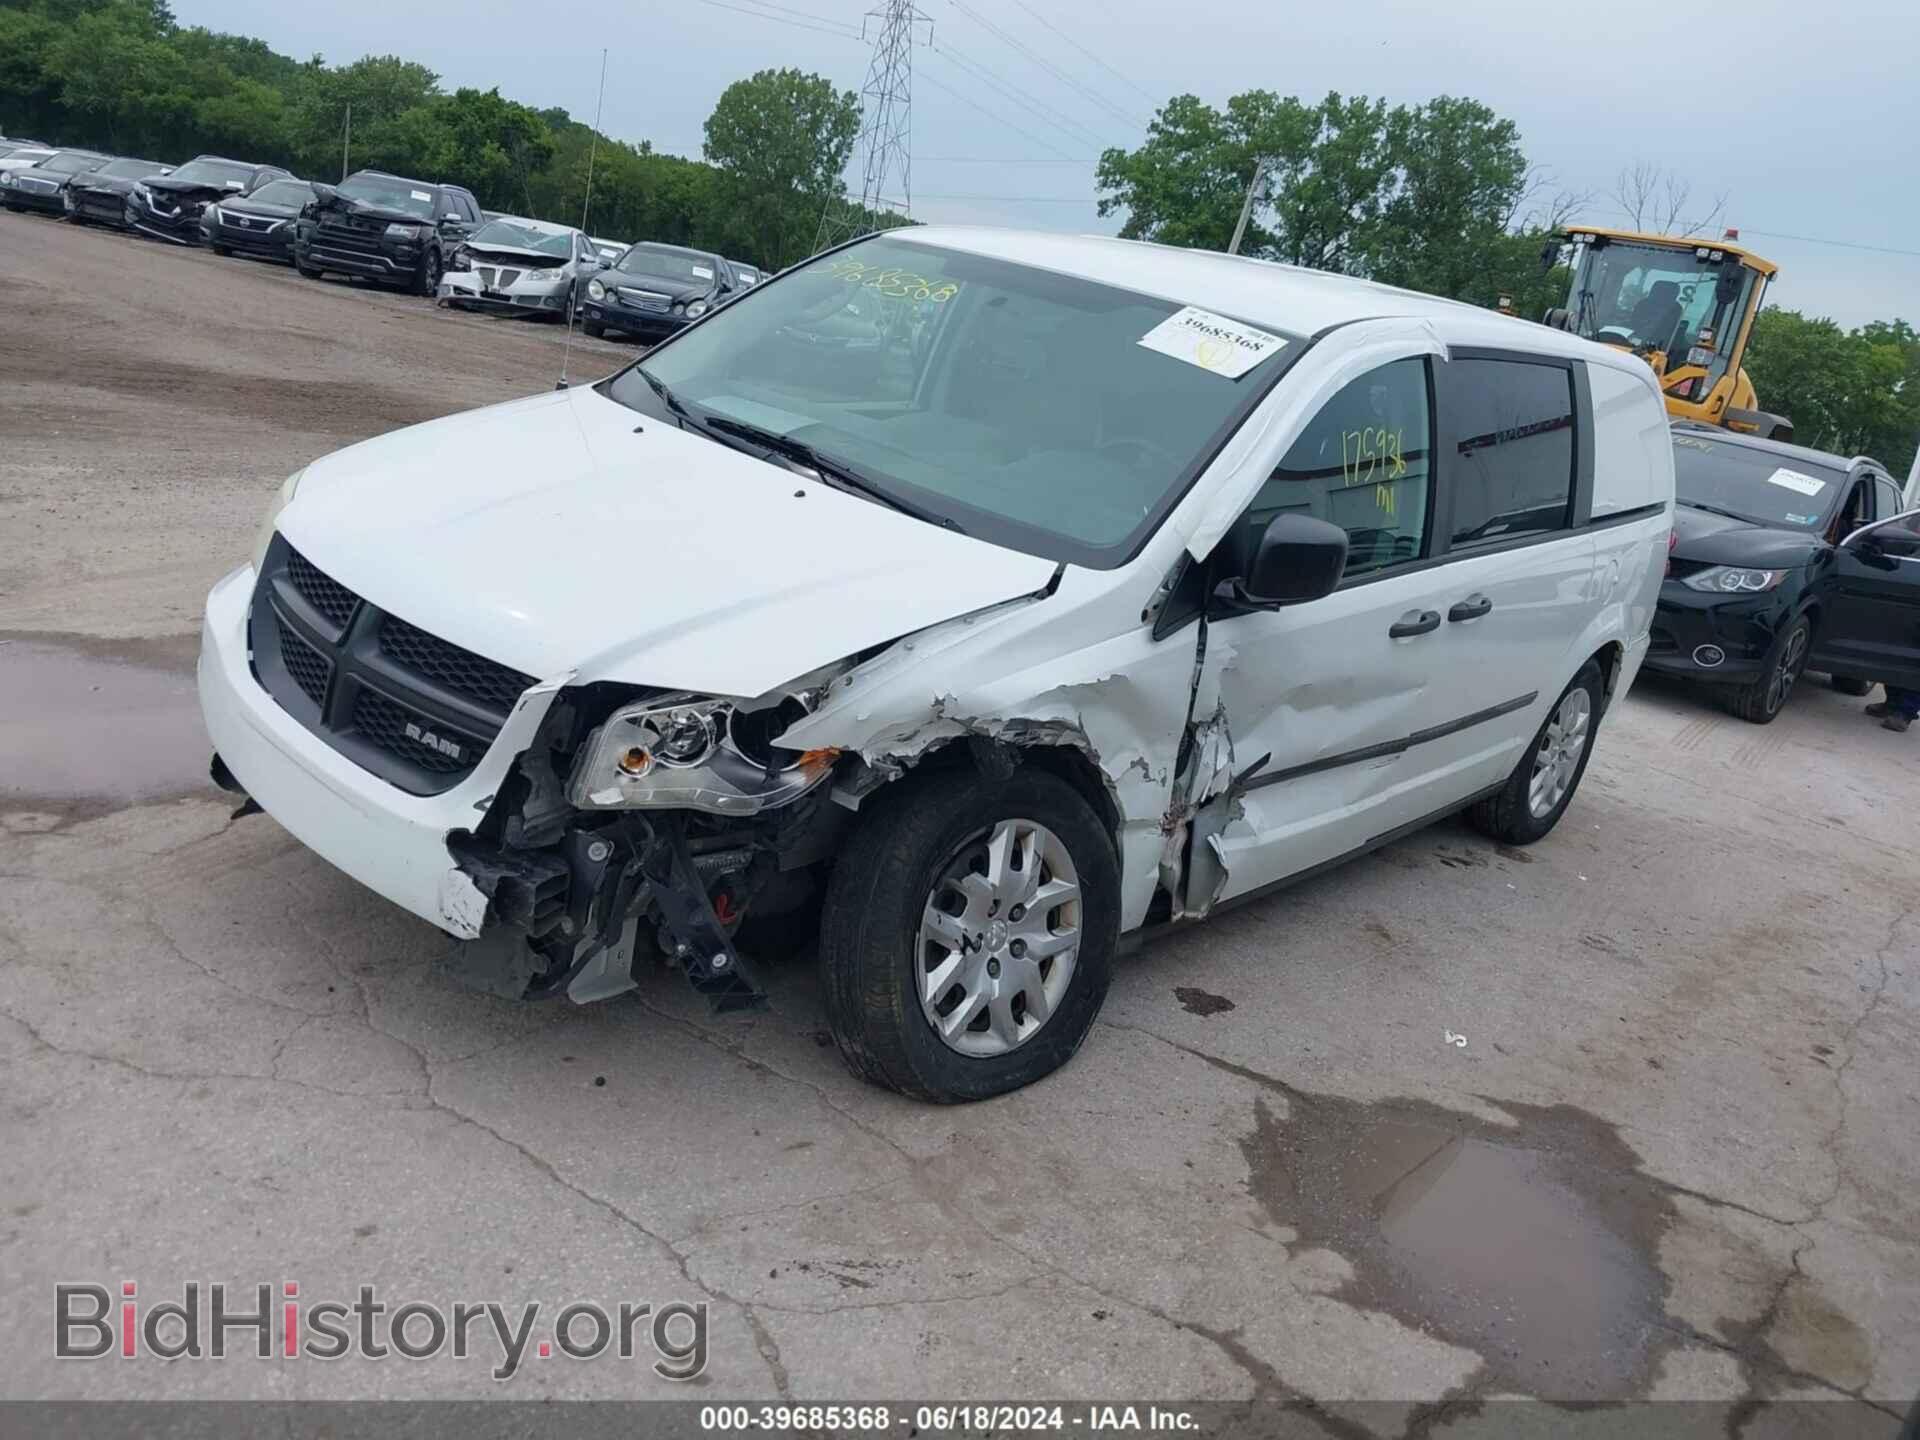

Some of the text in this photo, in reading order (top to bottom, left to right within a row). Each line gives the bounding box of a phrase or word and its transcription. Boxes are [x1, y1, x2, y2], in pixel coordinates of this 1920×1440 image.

[1178, 317, 1264, 351] 39685368
[1342, 427, 1407, 488] 175936
[405, 722, 460, 759] RAM
